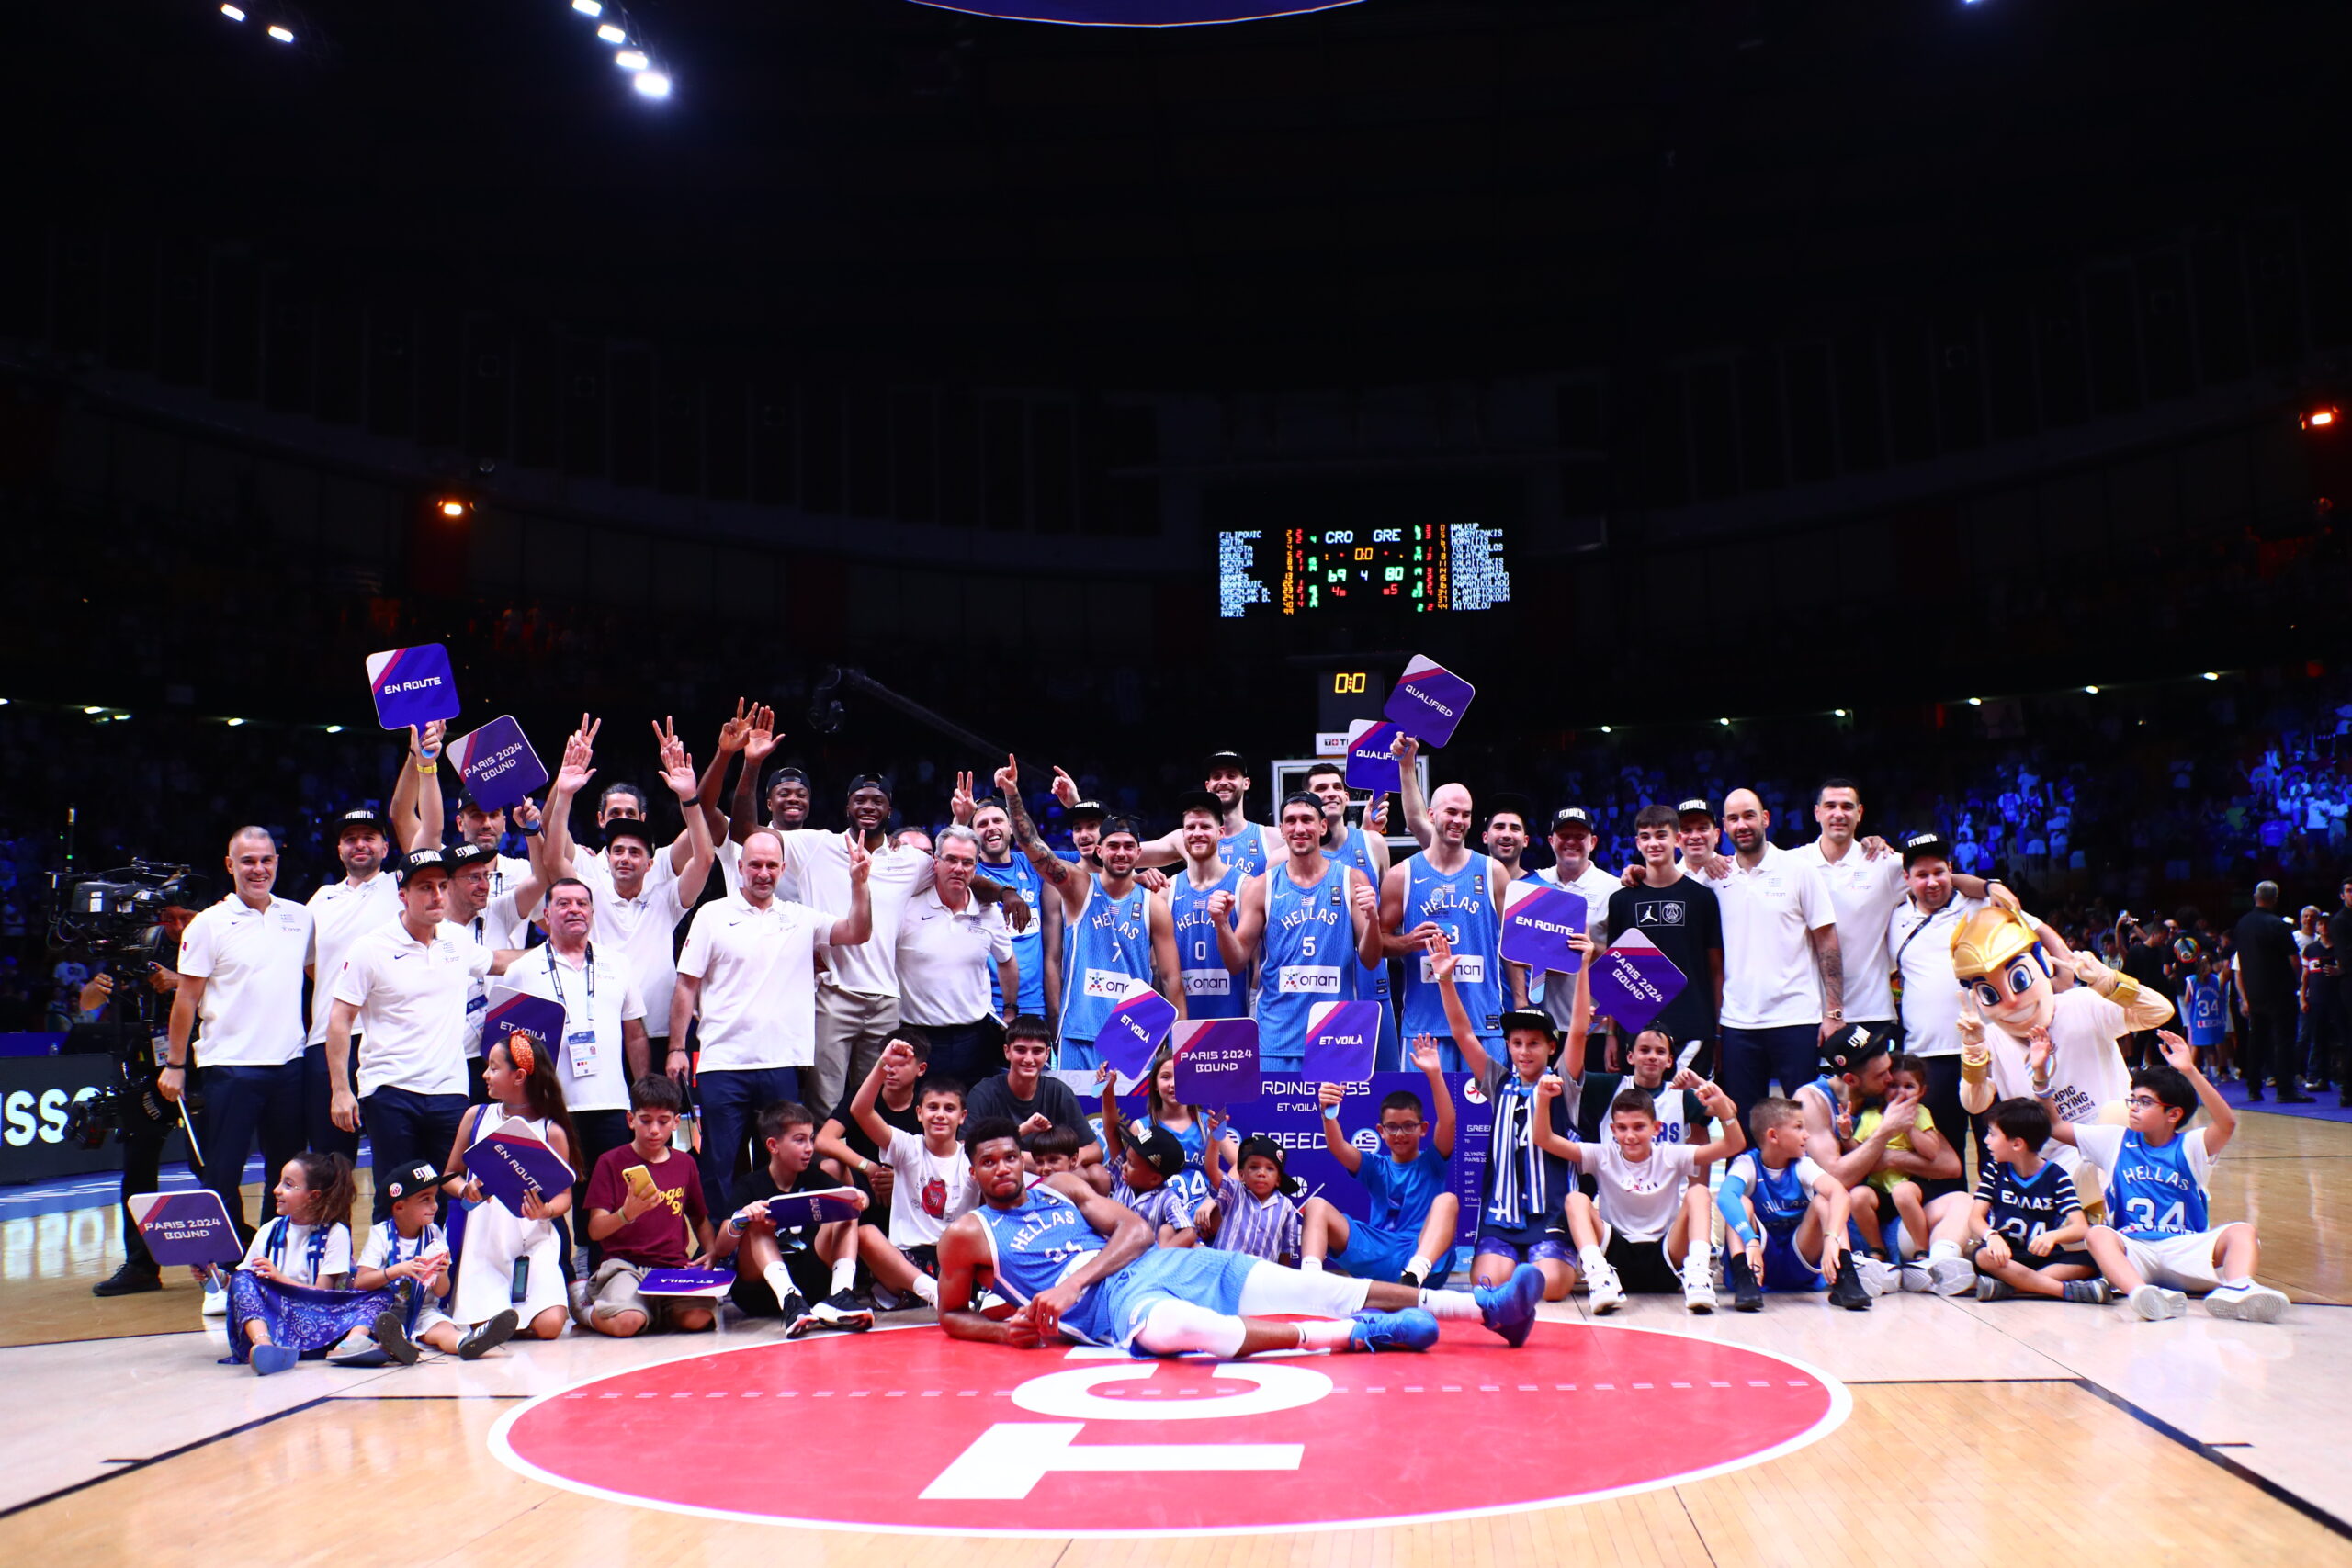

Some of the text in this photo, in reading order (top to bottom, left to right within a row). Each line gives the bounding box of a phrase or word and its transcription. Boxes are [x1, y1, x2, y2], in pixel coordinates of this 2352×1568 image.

[1325, 530, 1353, 544] CRO
[1373, 528, 1402, 542] GRE
[1328, 568, 1347, 583] 69
[1360, 570, 1368, 581] 4
[1385, 566, 1404, 581] 80
[1390, 583, 1398, 595] 5
[384, 676, 442, 694] EN ROUTE
[1405, 684, 1453, 717] QUALIFIED
[463, 742, 523, 778] PARIS 2024
[481, 759, 516, 782] BOUND
[1227, 855, 1255, 873] LAS
[1419, 894, 1480, 917] HELLAS
[1280, 907, 1338, 931] HELLAS
[1516, 916, 1574, 936] EN ROUTE
[1112, 942, 1122, 963] 7
[1195, 941, 1206, 961] 0
[1302, 936, 1316, 957] 5
[1610, 950, 1664, 1003] PARIS 2024
[1612, 968, 1645, 1001] BOUND
[2198, 999, 2219, 1017] 34
[500, 1021, 514, 1032] ET
[1120, 1013, 1133, 1026] ET
[1318, 1035, 1334, 1046] ET
[1180, 1049, 1253, 1062] PARIS 2024
[1195, 1062, 1238, 1073] BOUND
[1261, 1080, 1316, 1096] RDING
[2052, 1085, 2076, 1103] MPIC
[1276, 1101, 1317, 1112] ET VOILÀ
[2056, 1091, 2089, 1115] IFYING
[2077, 1100, 2096, 1114] 2024
[1466, 1124, 1491, 1133] GREE
[1184, 1150, 1205, 1167] LAS
[493, 1144, 544, 1194] EN ROUTE
[2122, 1165, 2189, 1191] HELLAS
[1167, 1170, 1208, 1205] 34
[2126, 1197, 2186, 1233] 34
[143, 1217, 221, 1233] PARIS 2024
[1010, 1210, 1075, 1251] HELLAS
[164, 1229, 209, 1241] BOUND
